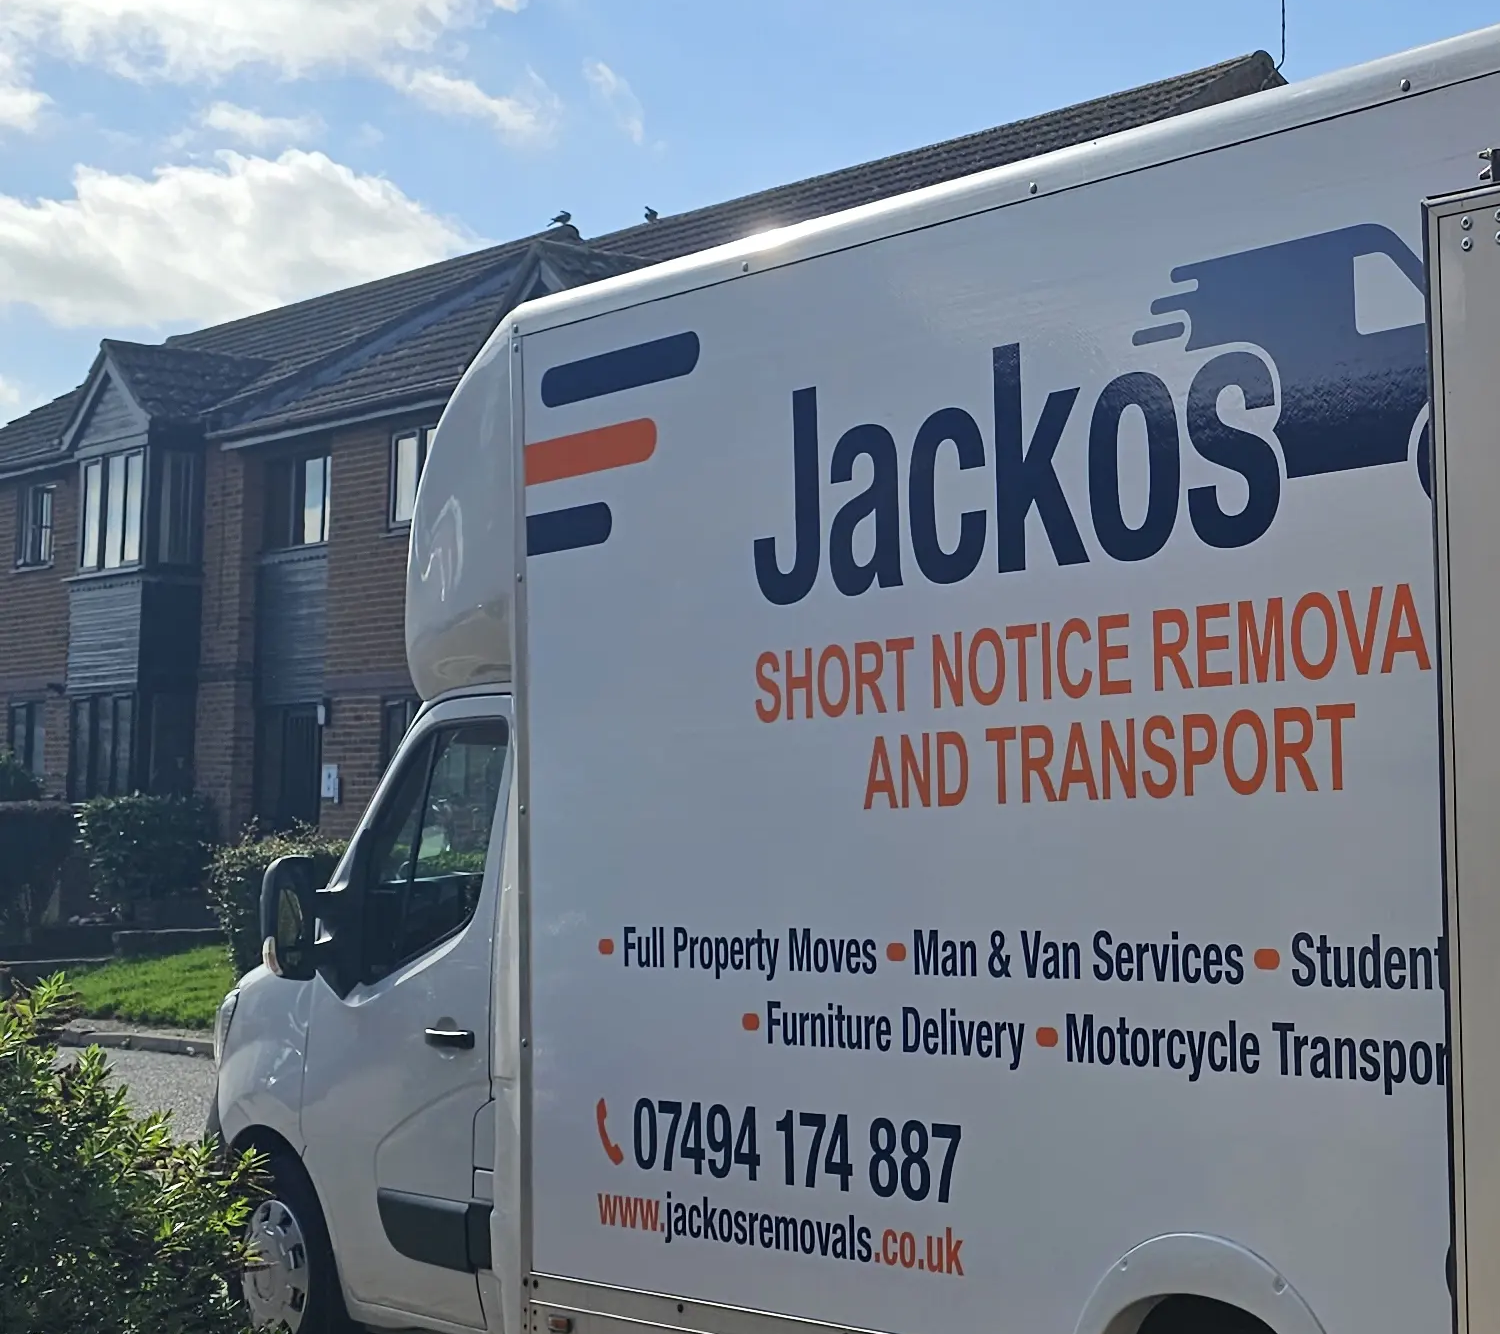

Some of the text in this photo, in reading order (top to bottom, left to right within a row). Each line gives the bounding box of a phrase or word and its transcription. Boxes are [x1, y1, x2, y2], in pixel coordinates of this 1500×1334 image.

[753, 343, 1281, 606] Jackos
[755, 637, 914, 723] SHORT
[932, 613, 1132, 709] NOTICE
[864, 704, 1356, 809] AND TRANSPORT
[623, 926, 665, 968] Full
[673, 927, 780, 981] Property
[788, 927, 877, 975] Moves
[913, 929, 978, 977] Man
[988, 929, 1012, 979] &
[1020, 930, 1081, 980] Van
[1093, 929, 1244, 985] Services
[766, 1001, 892, 1052] Furniture
[901, 1006, 1025, 1071] Delivery
[1066, 1013, 1260, 1082] Motorcycle
[633, 1097, 962, 1204] 07494 174 887
[597, 1191, 964, 1276] www.jackosremovals.co.uk
